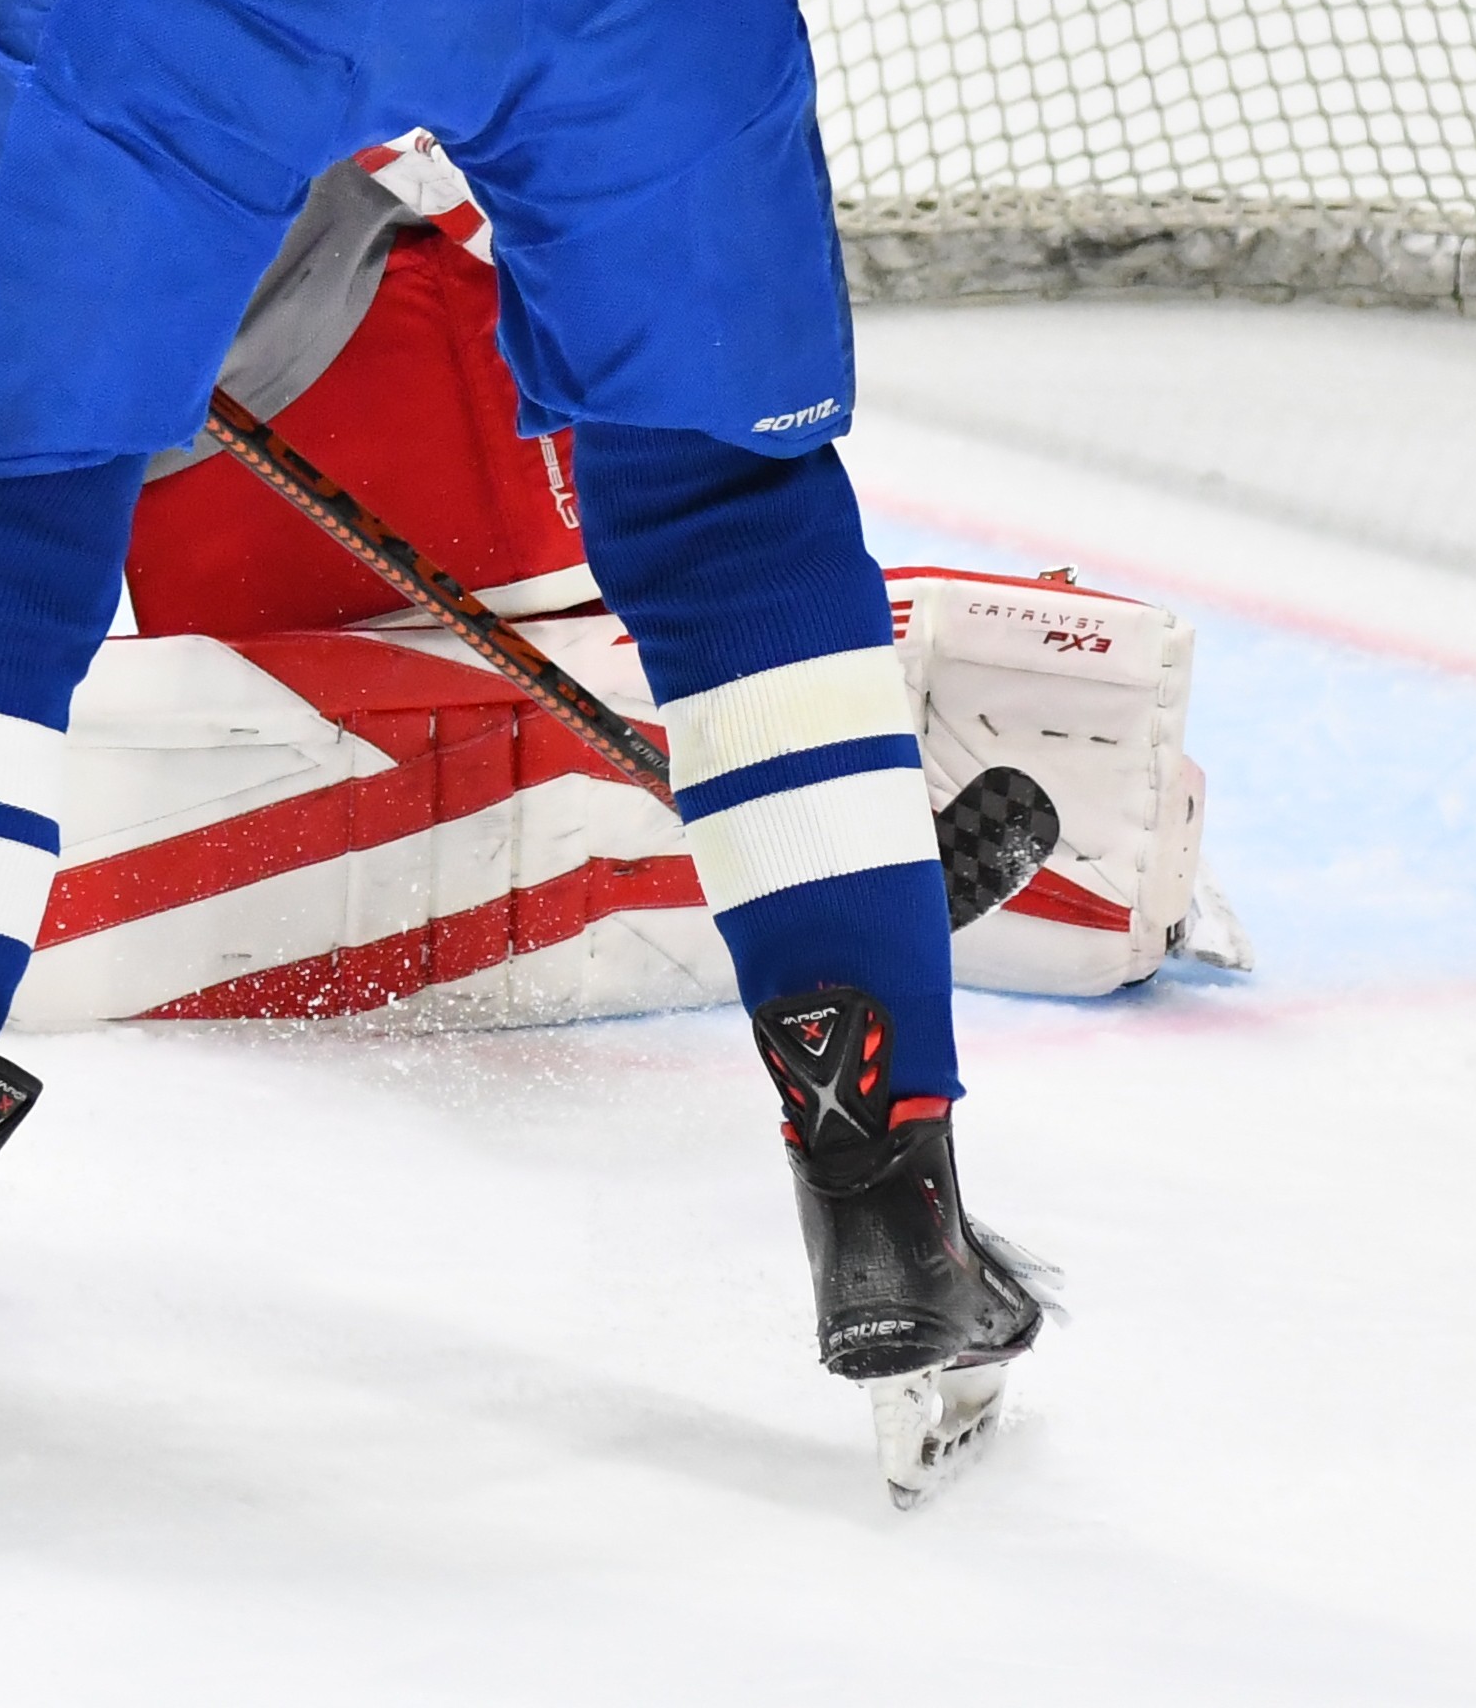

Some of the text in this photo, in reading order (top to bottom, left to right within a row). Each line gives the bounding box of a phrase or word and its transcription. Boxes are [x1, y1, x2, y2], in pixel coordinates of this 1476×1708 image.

[750, 397, 835, 433] SOYUZ
[968, 602, 1105, 631] CATALYST
[1042, 630, 1113, 654] PX3
[781, 1007, 841, 1026] VAPOR
